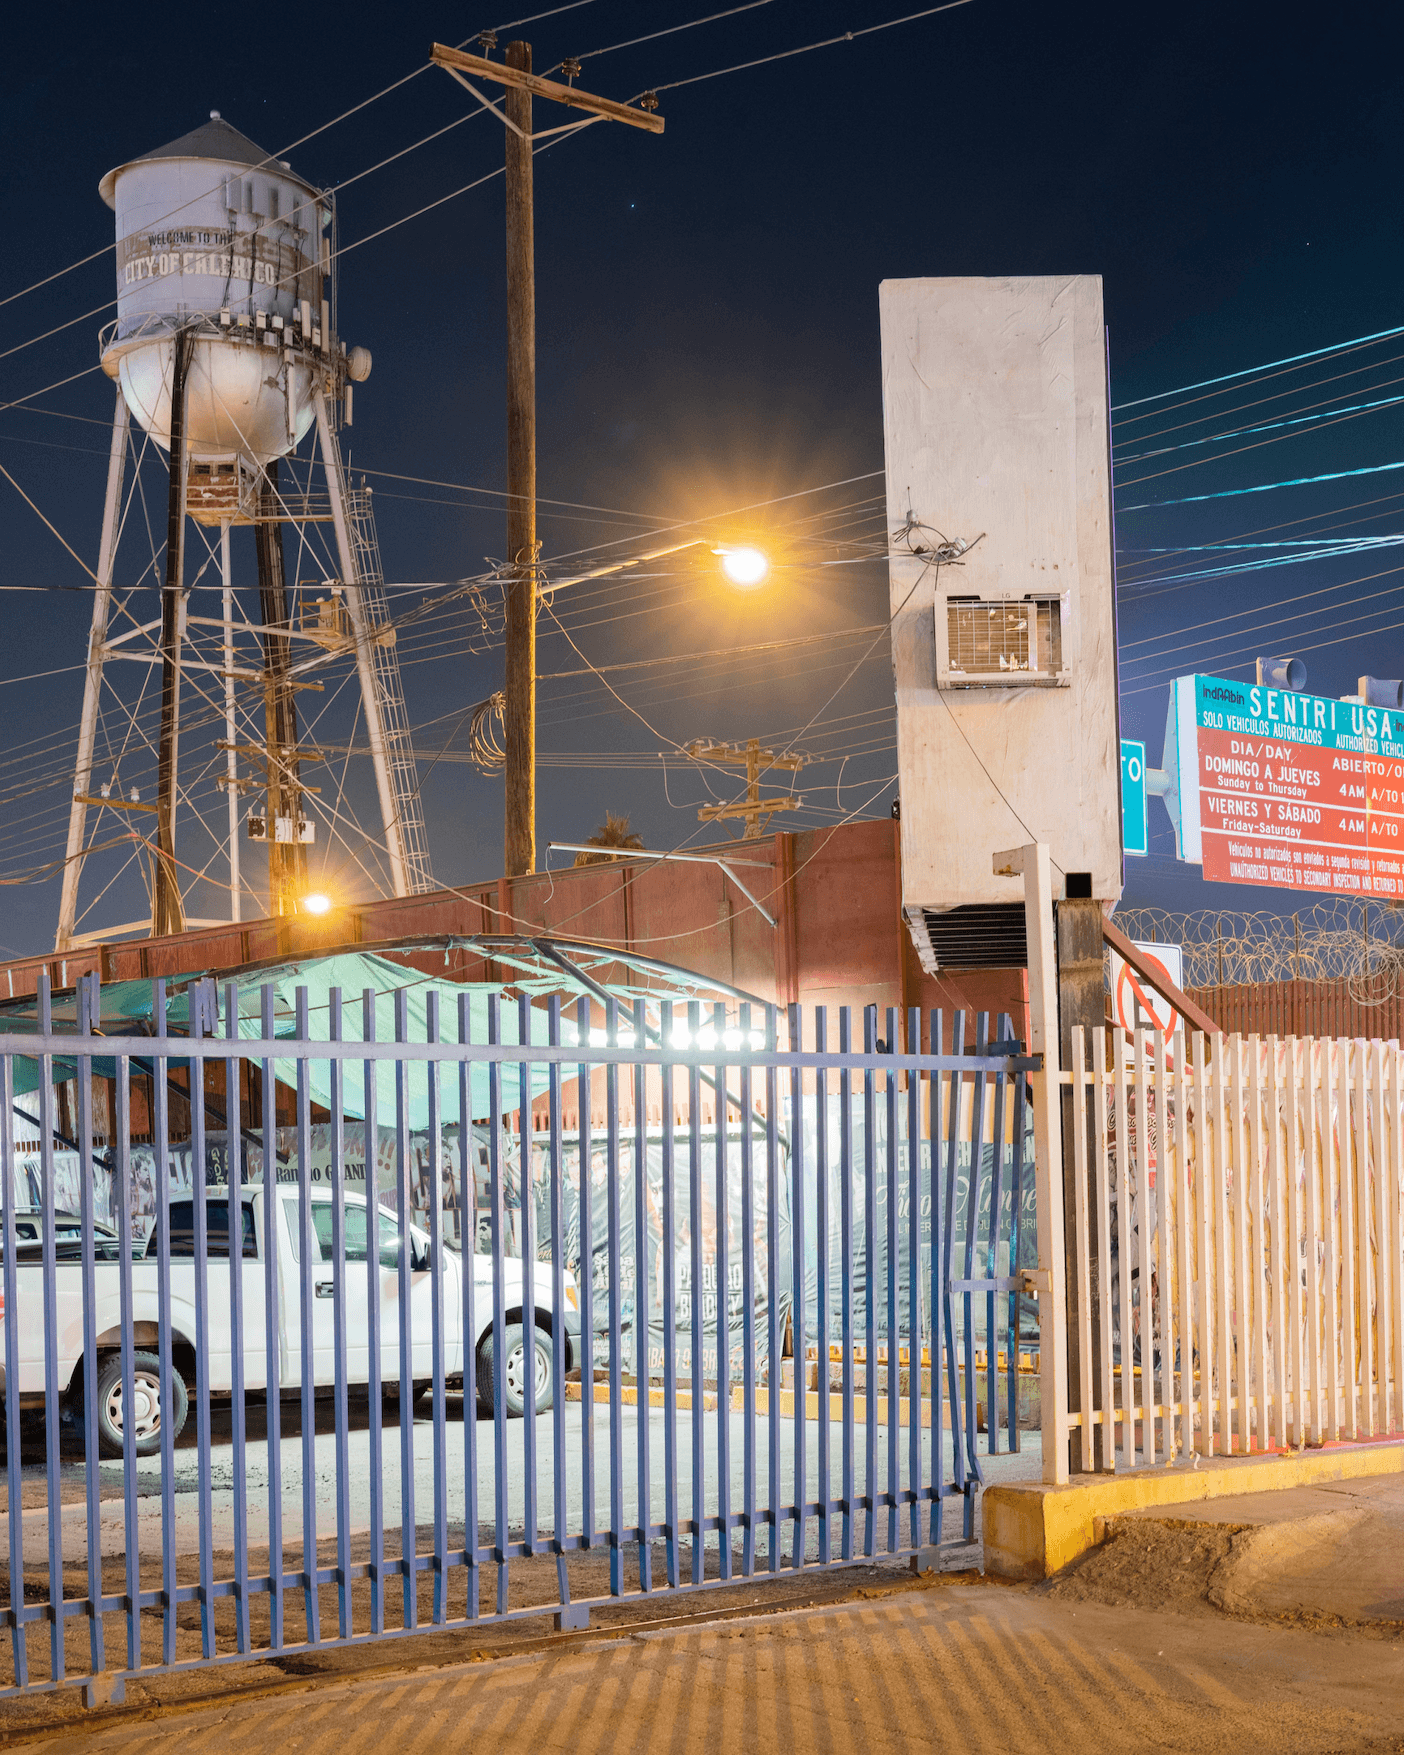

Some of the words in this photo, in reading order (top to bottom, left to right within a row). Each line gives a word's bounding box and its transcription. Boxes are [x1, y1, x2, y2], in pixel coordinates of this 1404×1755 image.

[148, 231, 194, 246] WELCOME
[197, 231, 210, 243] TO
[125, 254, 156, 285] CITY
[158, 252, 180, 276] OF
[1250, 687, 1336, 731] SENTRI
[1352, 706, 1393, 740] USA
[1203, 710, 1224, 729] SOLO
[1226, 714, 1270, 736] VEHICULOS
[1273, 722, 1322, 746] AUTORIZADOS
[1335, 733, 1379, 754] AUTHORIZED
[1205, 755, 1260, 778] DOMINGO
[1264, 764, 1273, 780] A
[1277, 765, 1320, 787] JUEVES
[1217, 775, 1251, 792] Sunday
[1255, 780, 1264, 791] to
[1268, 781, 1308, 799] Thursday
[1208, 796, 1258, 818] VIERNES
[1264, 803, 1272, 819] Y
[1278, 802, 1321, 825] SÁBADO
[1263, 846, 1292, 863] autorizados
[1230, 862, 1268, 881] UNAUTHORIZED
[1270, 866, 1295, 884] VEHICLES
[1295, 869, 1303, 885] TO
[1303, 869, 1332, 887] SECONDARY
[1333, 873, 1361, 890] INSPECTION
[1361, 875, 1372, 891] AND
[1373, 876, 1396, 893] RETURNED
